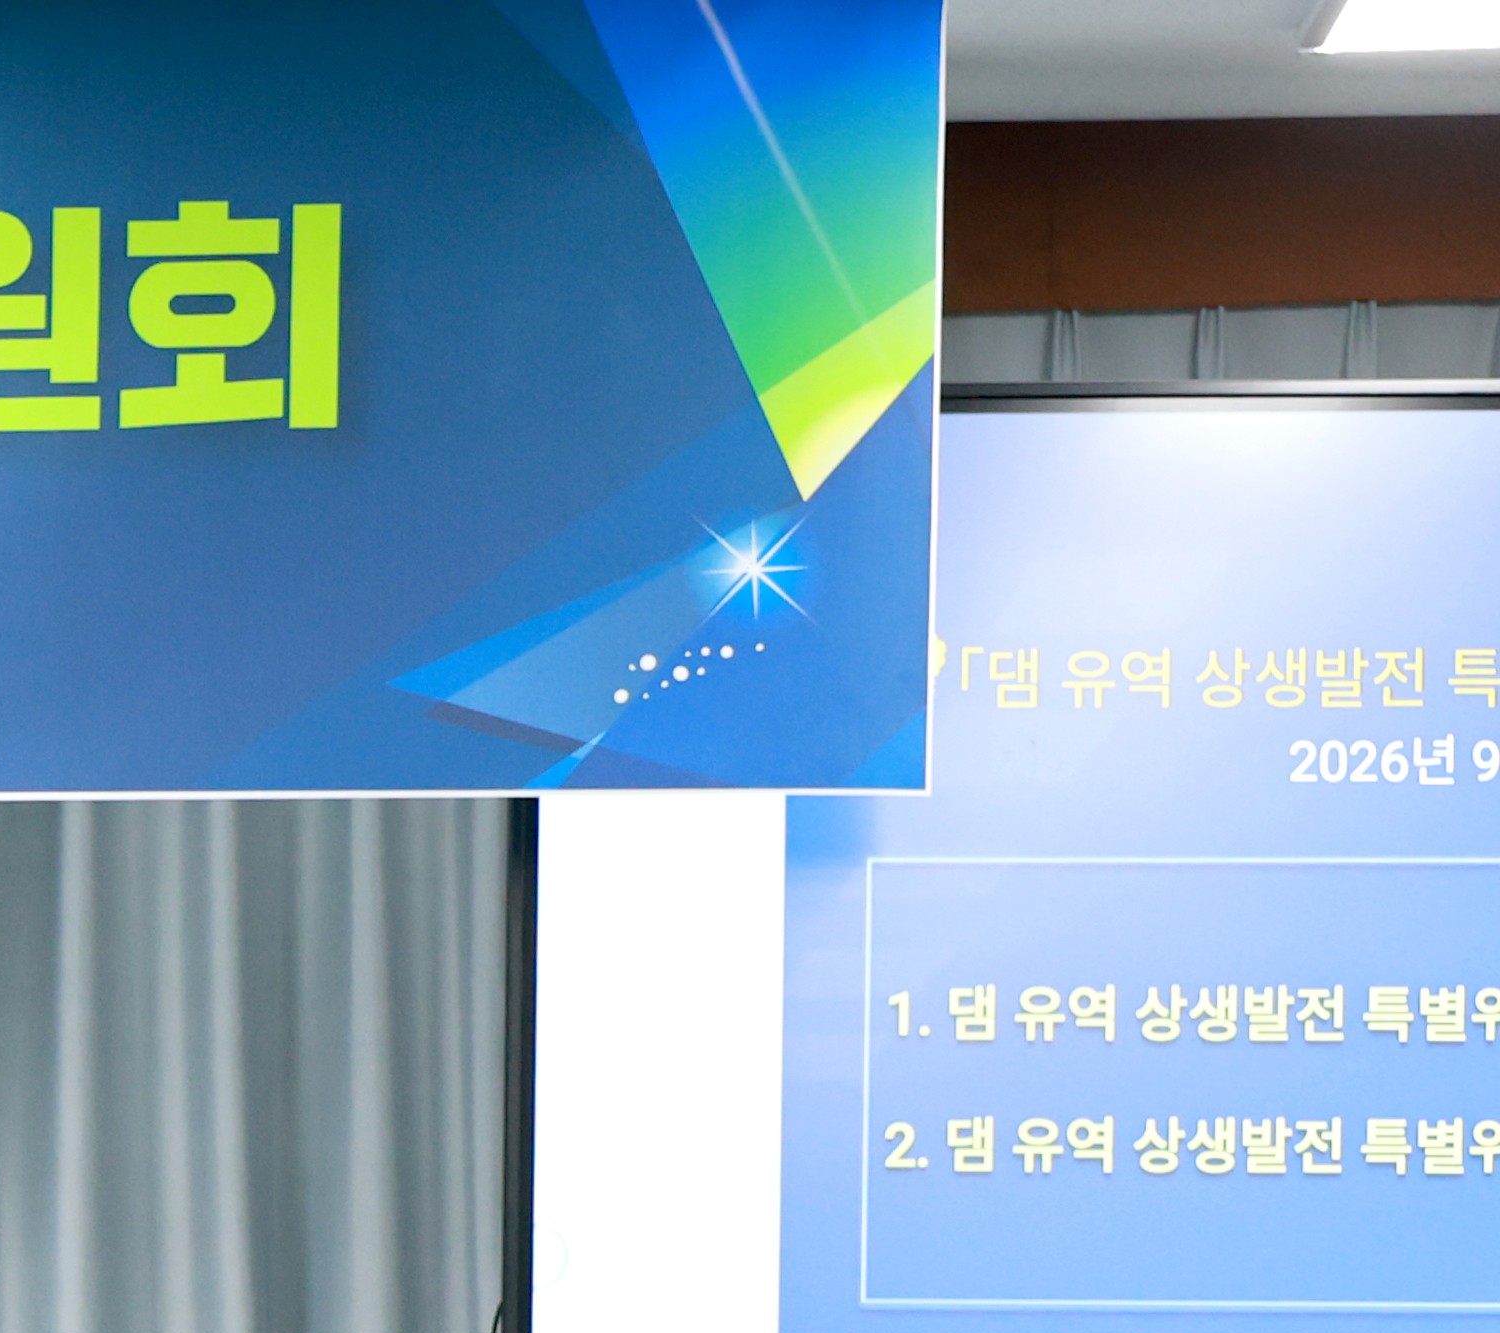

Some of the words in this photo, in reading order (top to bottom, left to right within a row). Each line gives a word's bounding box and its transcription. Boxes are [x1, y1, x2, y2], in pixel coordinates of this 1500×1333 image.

[1062, 647, 1172, 708] 유역
[1196, 647, 1425, 708] 상생발전
[1289, 733, 1456, 785] 2026년
[888, 991, 931, 1037] 1.
[948, 984, 997, 1042] 댐
[1014, 984, 1117, 1042] 유역
[1135, 984, 1345, 1043] 상생발전
[884, 1122, 929, 1169] 2.
[946, 1115, 996, 1174] 댐
[1012, 1115, 1115, 1174] 유역
[1133, 1116, 1343, 1175] 상생발전
